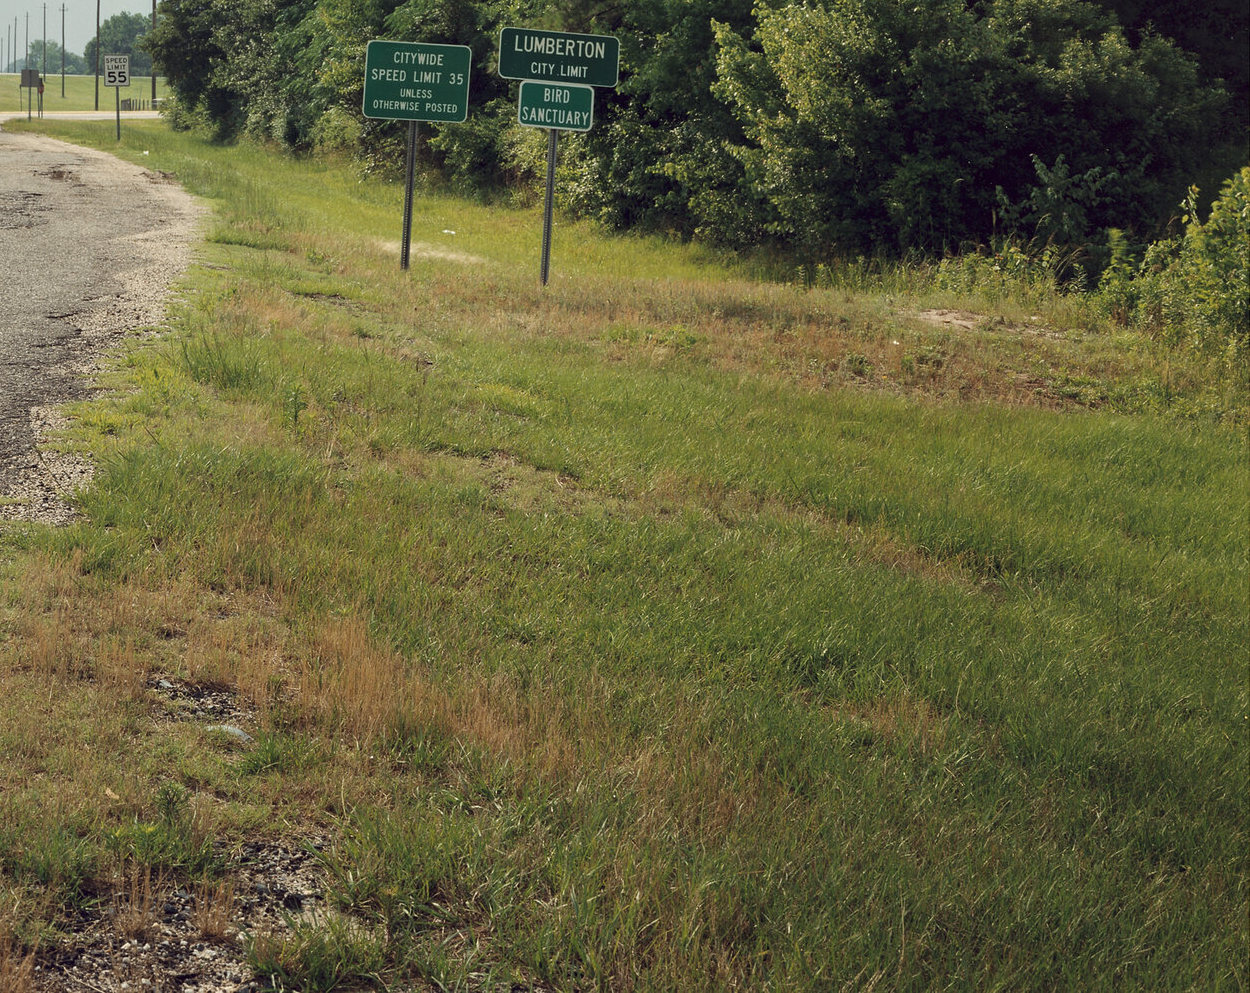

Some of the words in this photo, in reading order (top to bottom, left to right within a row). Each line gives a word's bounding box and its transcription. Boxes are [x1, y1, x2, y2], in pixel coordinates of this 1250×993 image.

[514, 35, 605, 59] LUMBERTON
[394, 51, 444, 66] CITYWIDE
[108, 71, 126, 83] 55
[371, 68, 407, 82] SPEED
[413, 71, 442, 84] LIMIT
[449, 73, 464, 85] 35
[531, 62, 555, 75] CITY
[560, 65, 588, 78] LIMIT
[400, 88, 433, 99] UNLESS
[543, 88, 570, 104] BIRD
[373, 99, 420, 111] OTHERWISE
[425, 103, 458, 113] POSTED
[522, 106, 589, 126] SANCTUARY
